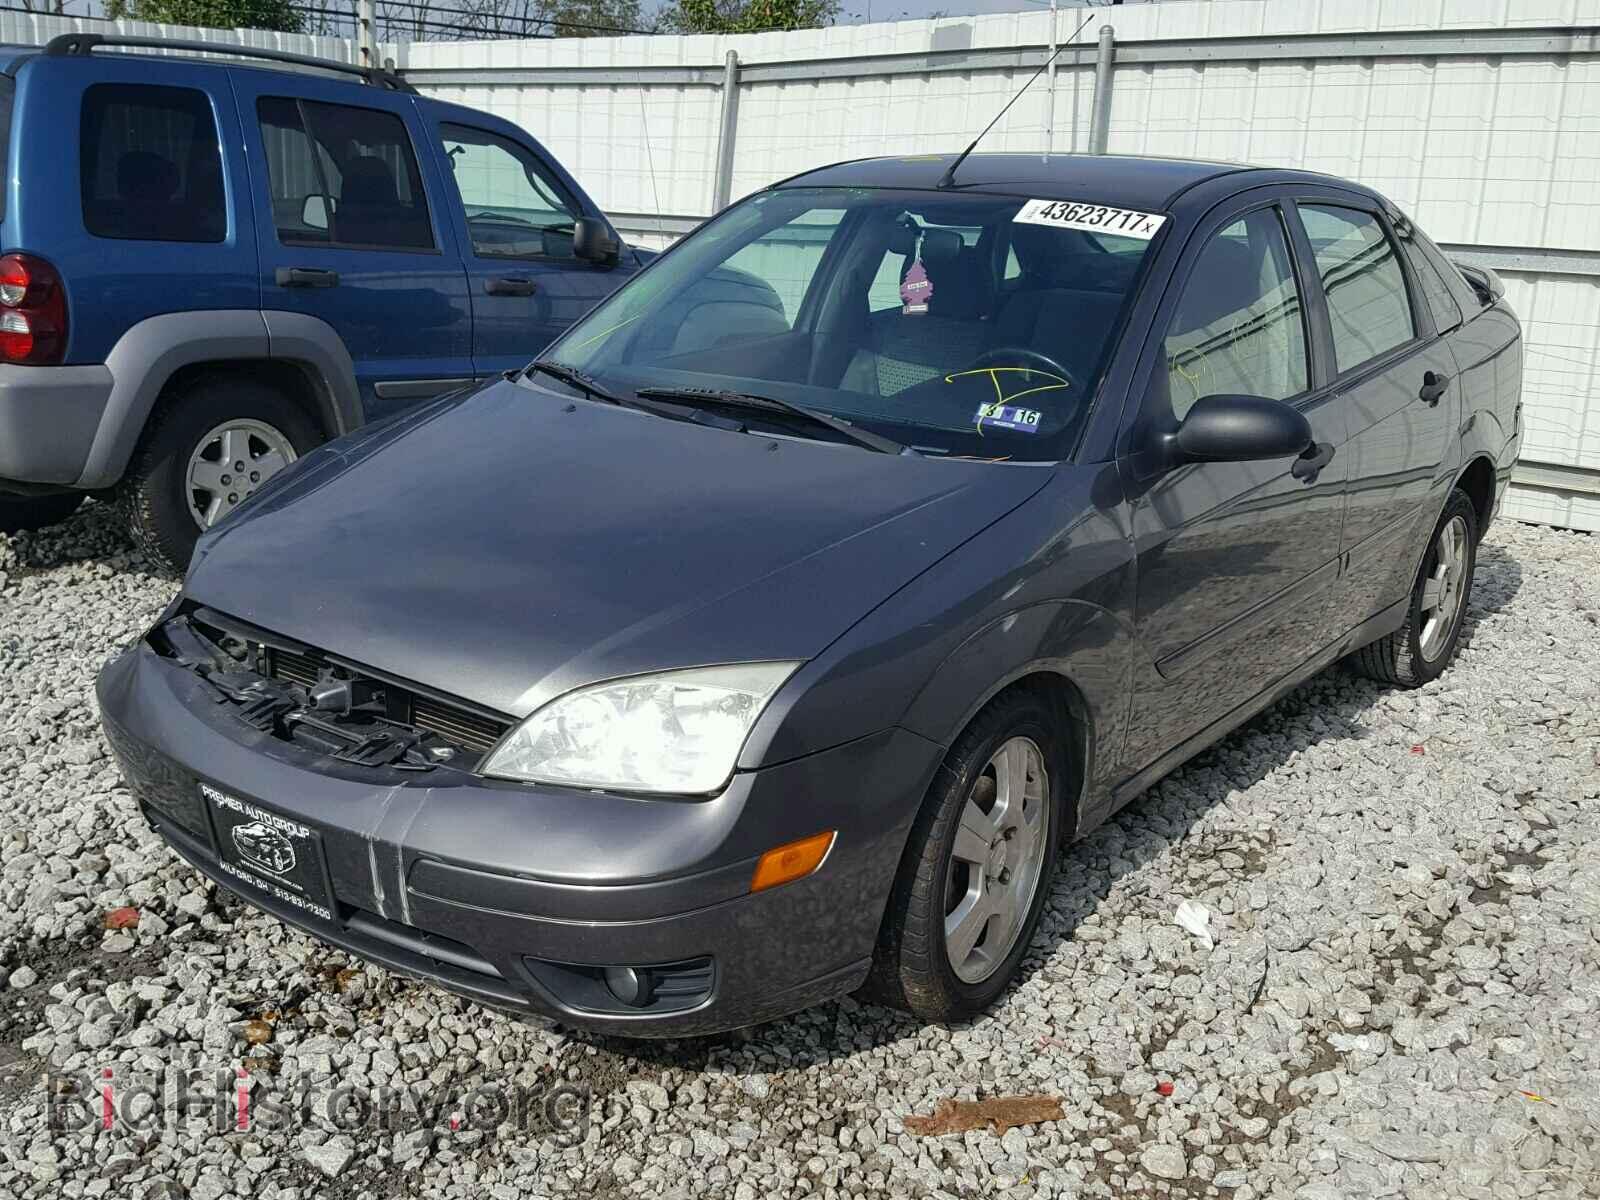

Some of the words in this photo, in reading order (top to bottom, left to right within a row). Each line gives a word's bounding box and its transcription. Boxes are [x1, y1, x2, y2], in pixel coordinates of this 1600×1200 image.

[1020, 410, 1035, 424] 16
[202, 785, 244, 814] PREMIER
[245, 804, 272, 825] AUTO
[272, 816, 310, 838] GROUP
[256, 879, 269, 891] OH
